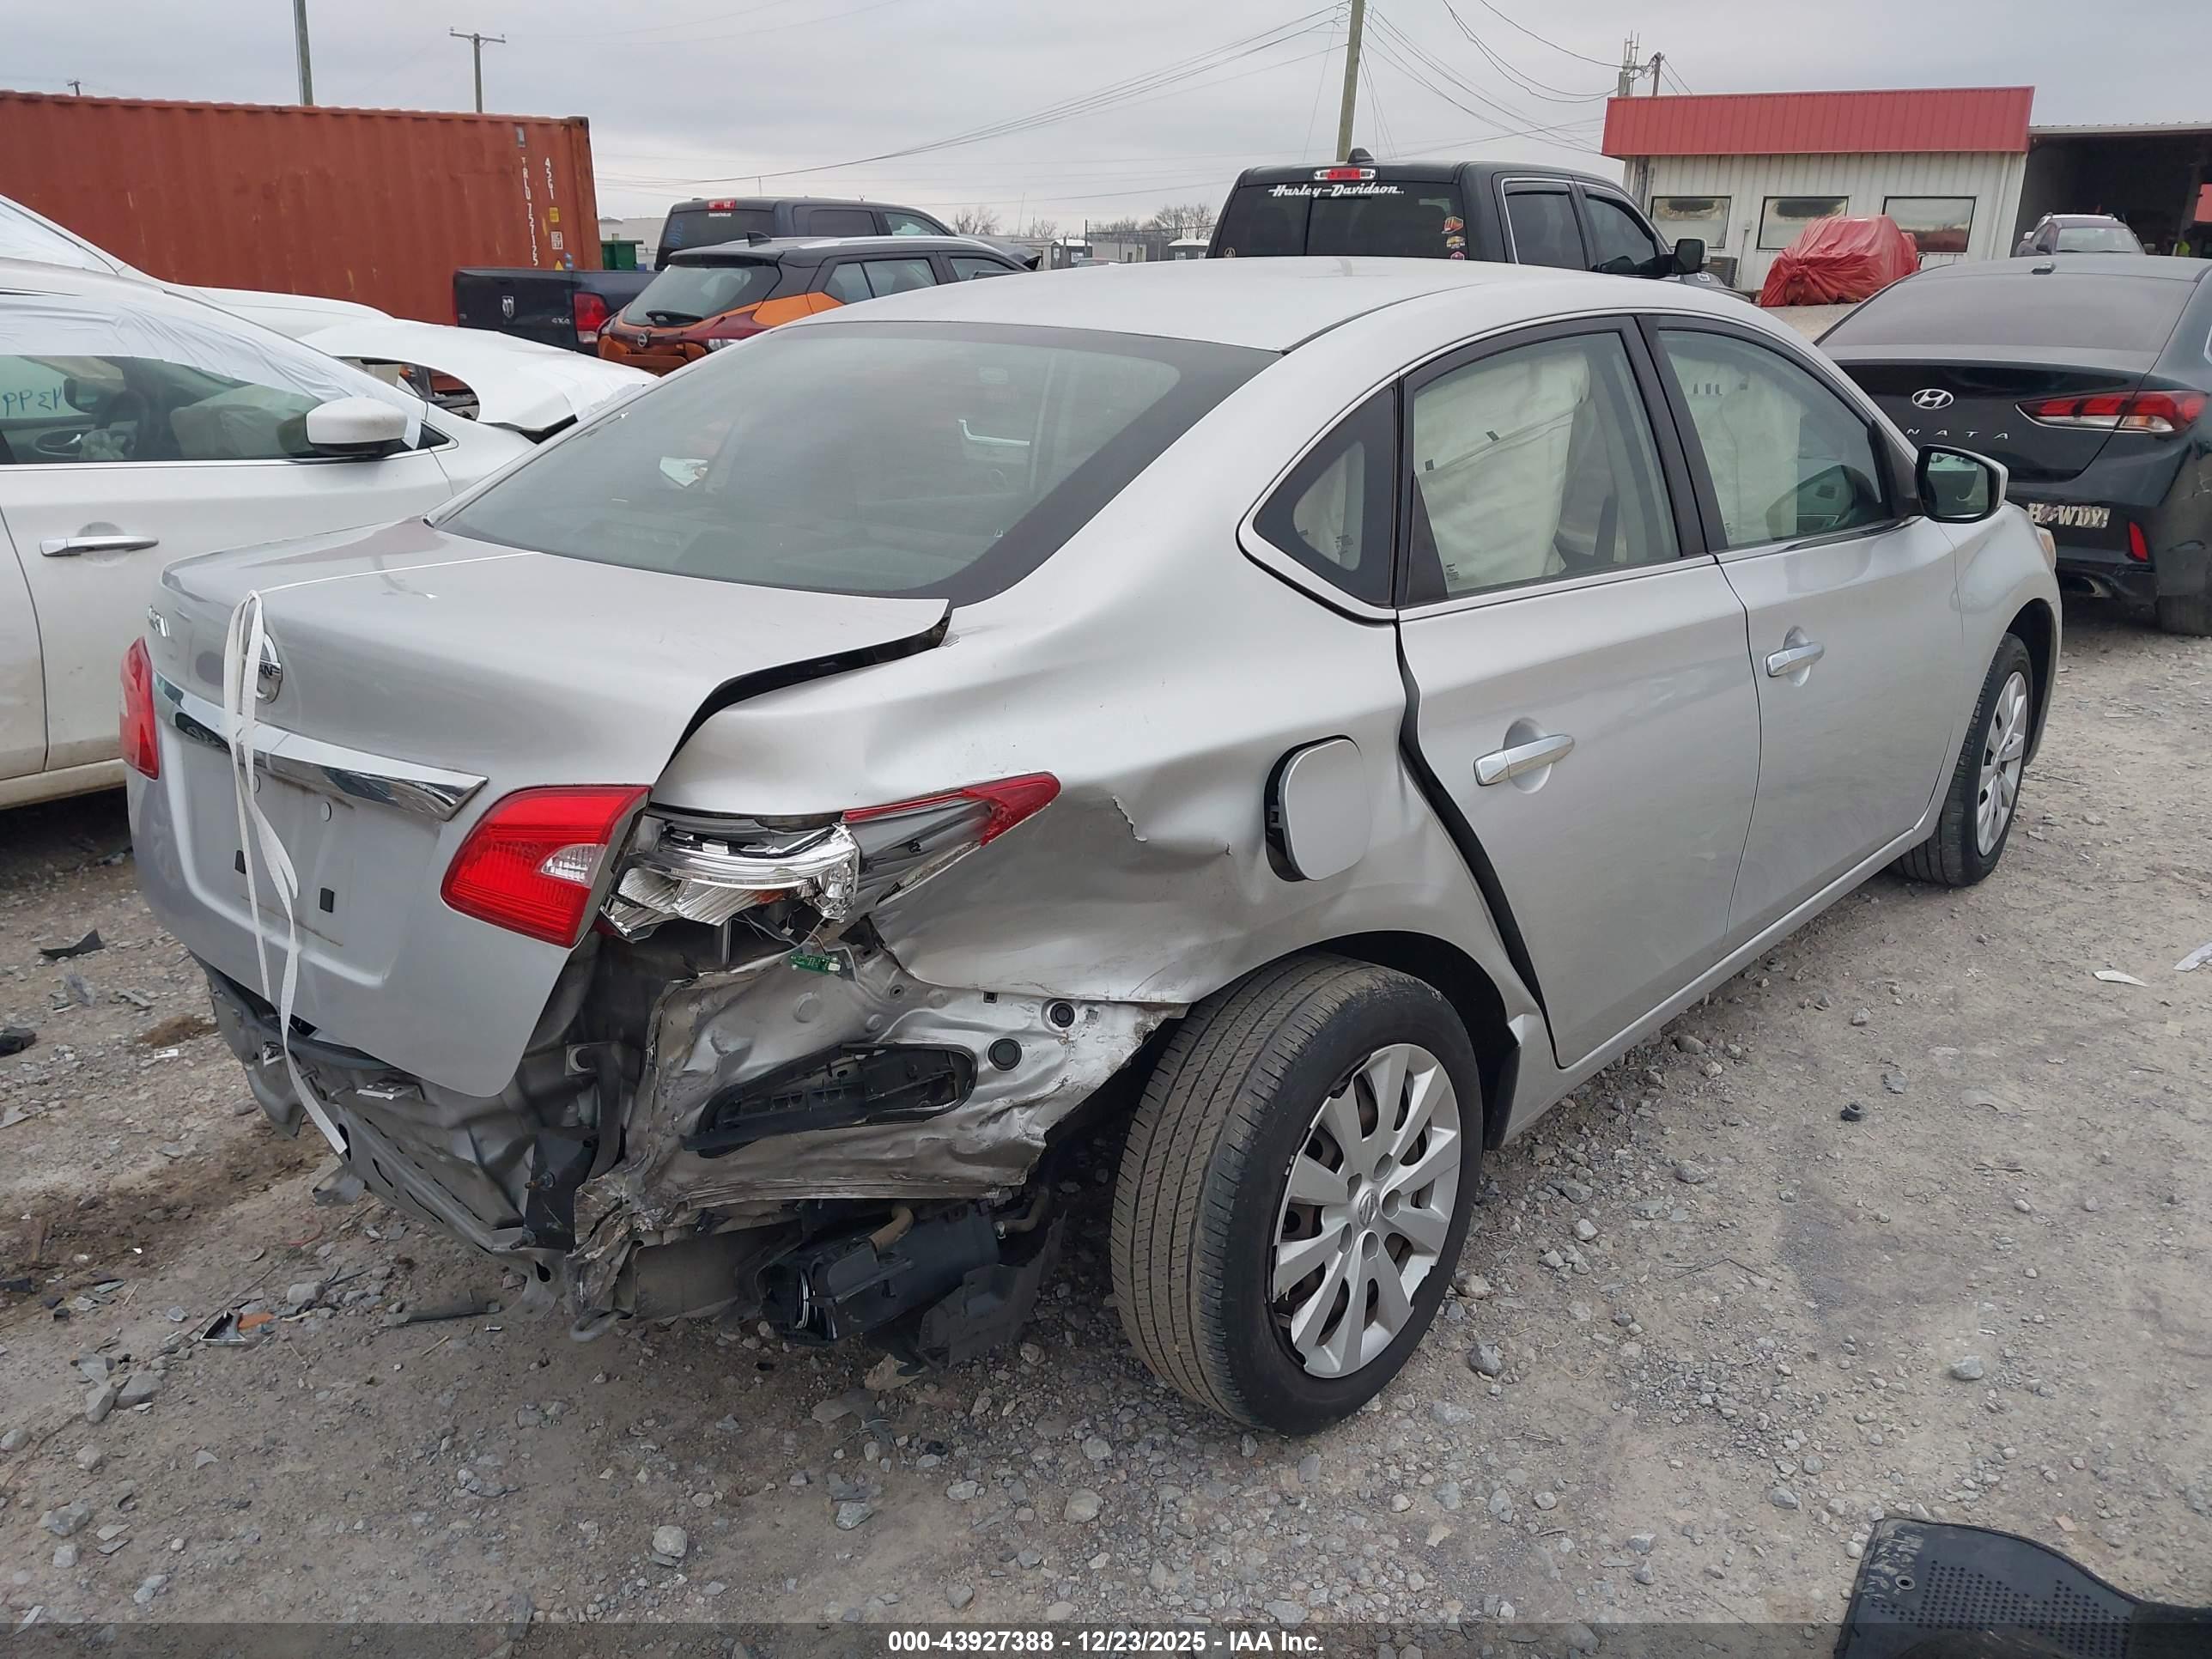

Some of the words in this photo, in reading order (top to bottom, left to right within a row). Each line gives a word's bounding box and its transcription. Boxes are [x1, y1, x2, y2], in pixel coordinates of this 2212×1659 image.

[521, 157, 532, 200] TRLU
[1905, 428, 2009, 441] NATA
[2027, 502, 2111, 528] HWDY!
